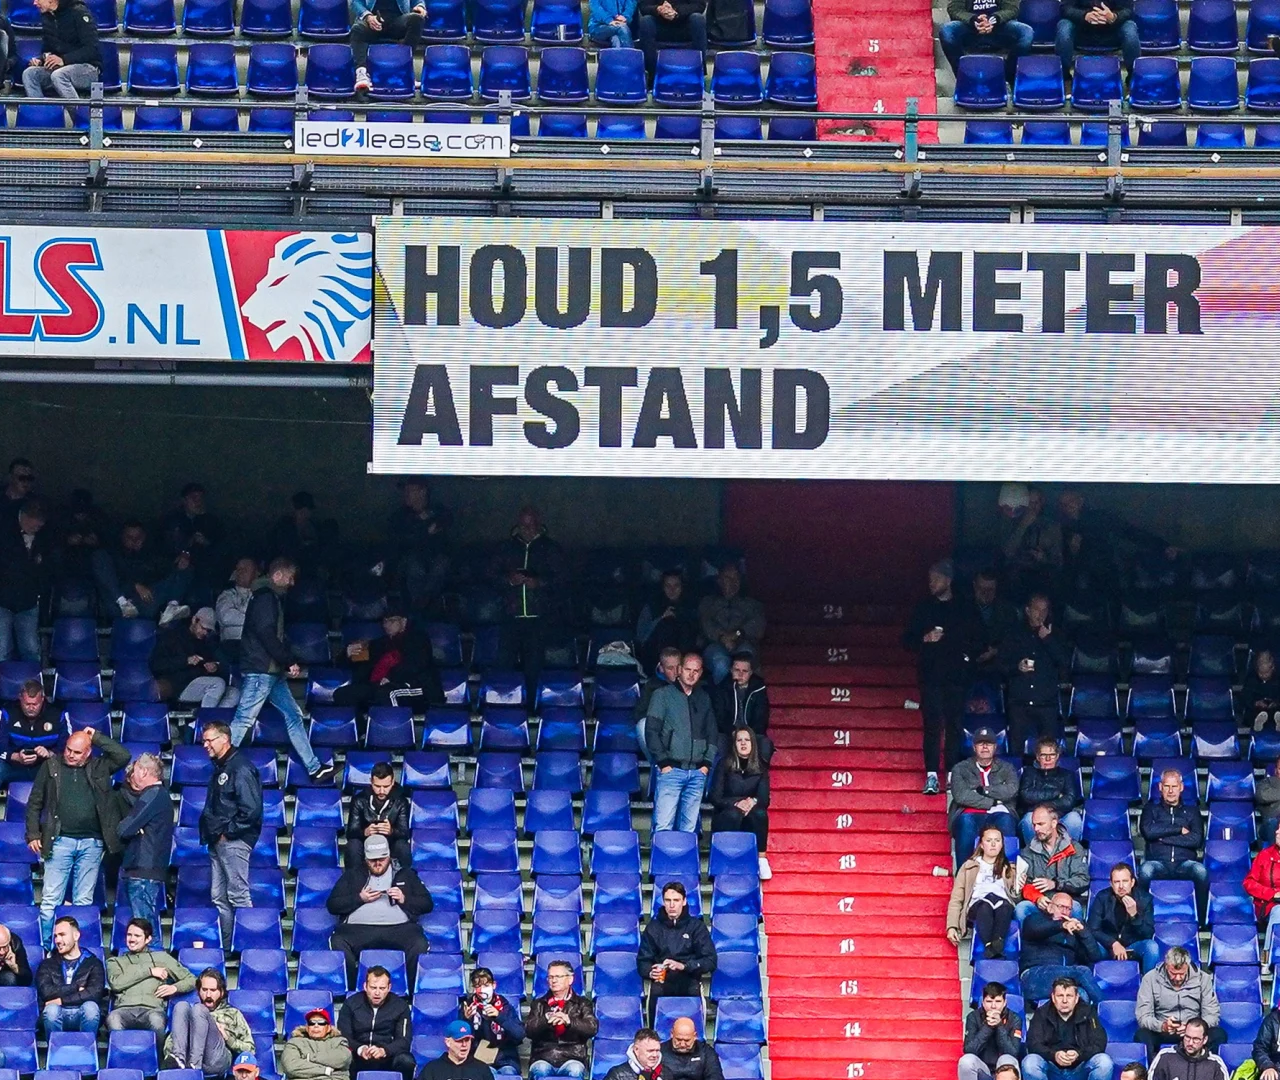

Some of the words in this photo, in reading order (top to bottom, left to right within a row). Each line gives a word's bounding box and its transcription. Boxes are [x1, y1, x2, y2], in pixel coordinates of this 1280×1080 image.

[868, 39, 880, 54] 5
[872, 99, 886, 112] 4
[301, 126, 503, 152] led2lease.com
[403, 243, 658, 330] HOUD
[700, 249, 843, 349] 1,5
[883, 250, 1202, 335] METER
[397, 363, 830, 450] AFSTAND
[830, 687, 852, 703] 22
[832, 730, 851, 747] 21
[831, 772, 853, 787] 20
[835, 813, 854, 829] 19
[838, 854, 857, 870] 18
[837, 897, 855, 914] 17
[838, 938, 856, 954] 16
[839, 980, 859, 996] 15
[843, 1022, 862, 1038] 14
[846, 1062, 865, 1079] 13
